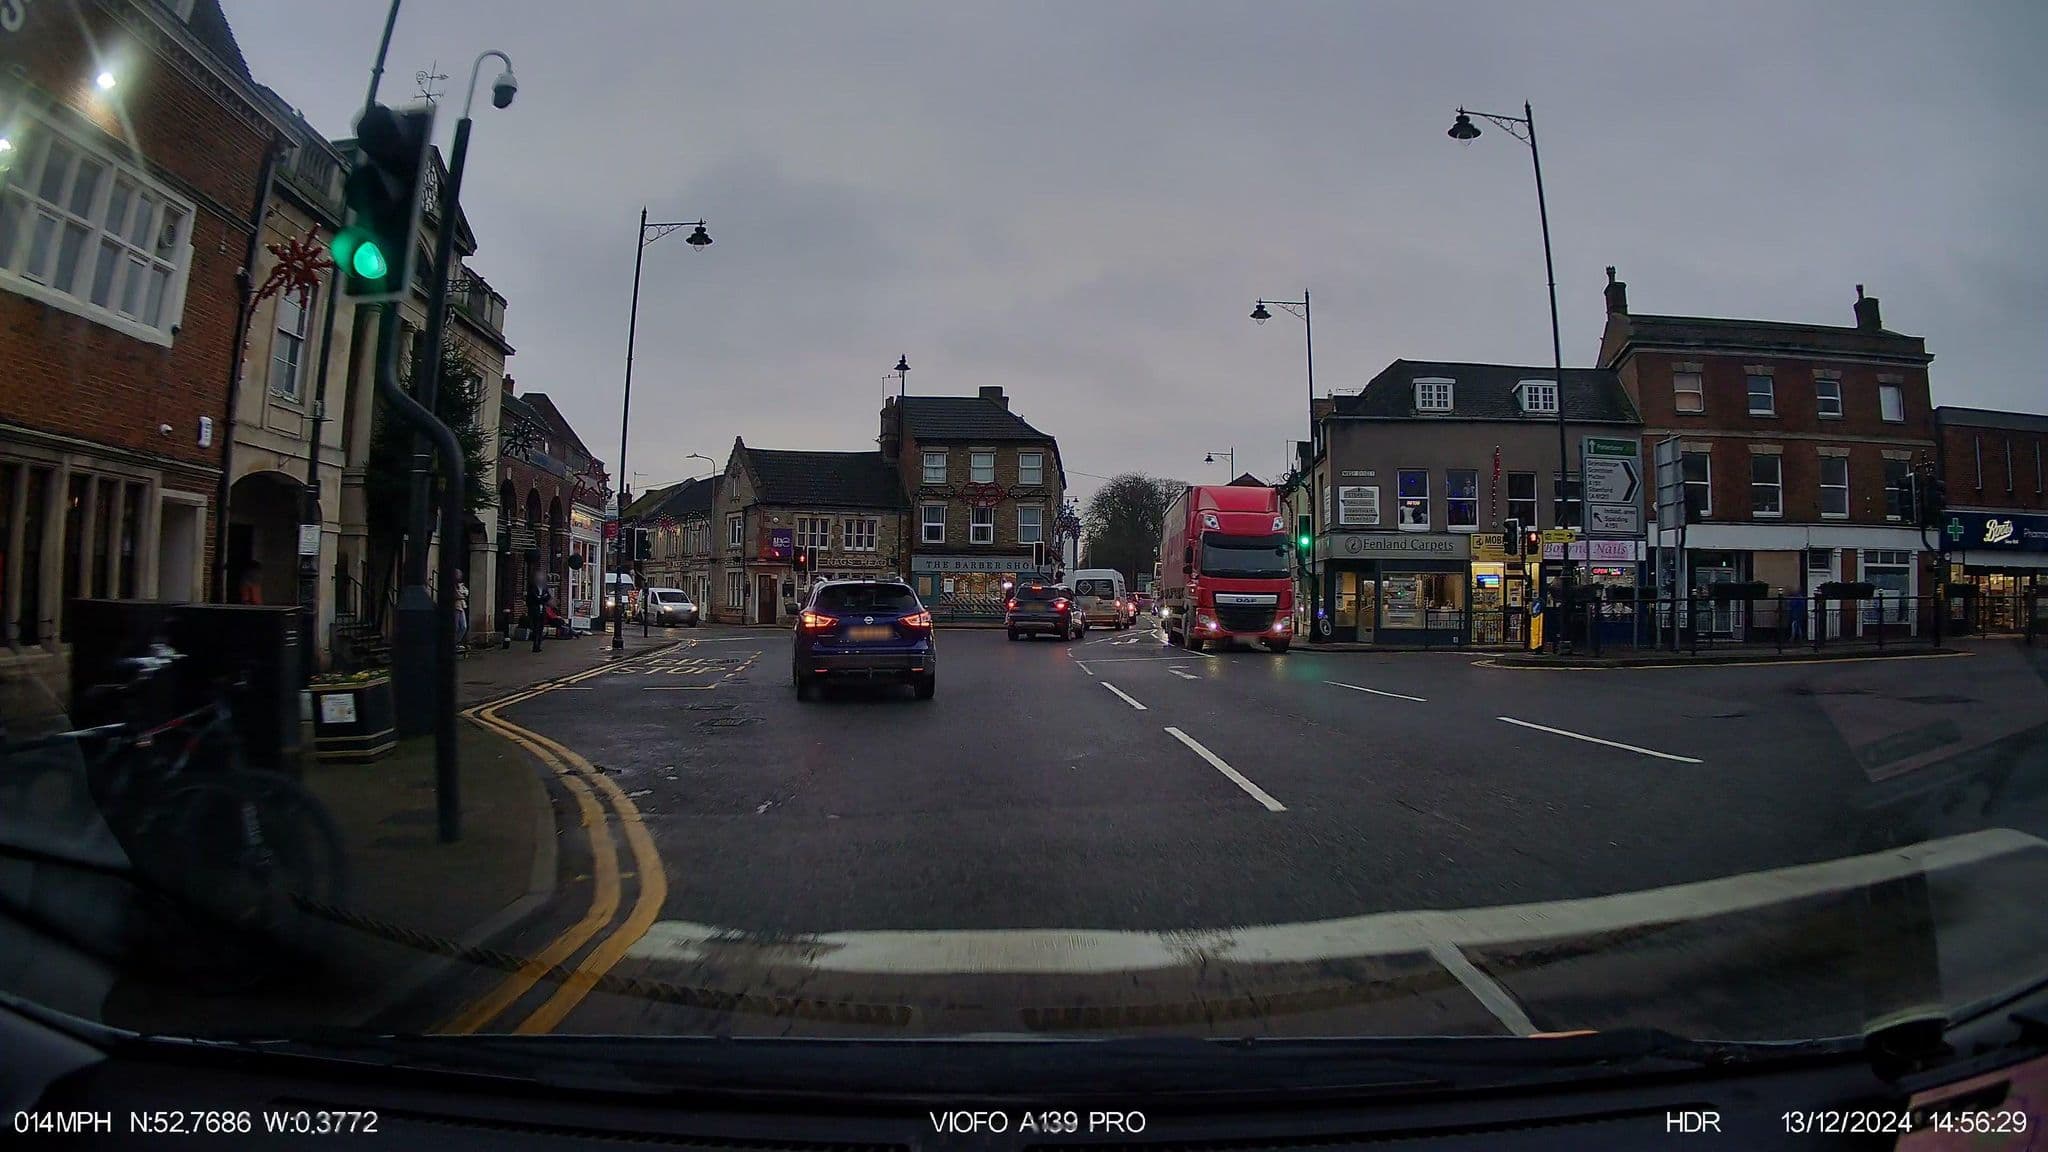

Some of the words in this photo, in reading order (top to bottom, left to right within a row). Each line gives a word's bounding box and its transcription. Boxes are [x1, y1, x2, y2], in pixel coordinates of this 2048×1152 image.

[1983, 519, 2014, 542] Boots
[1363, 538, 1407, 549] Fenland
[1411, 538, 1454, 551] Carpets
[1593, 543, 1626, 554] Nails
[926, 561, 949, 569] THE
[955, 561, 1001, 569] BARBER
[1007, 561, 1034, 570] SHO
[612, 666, 726, 675] STOP
